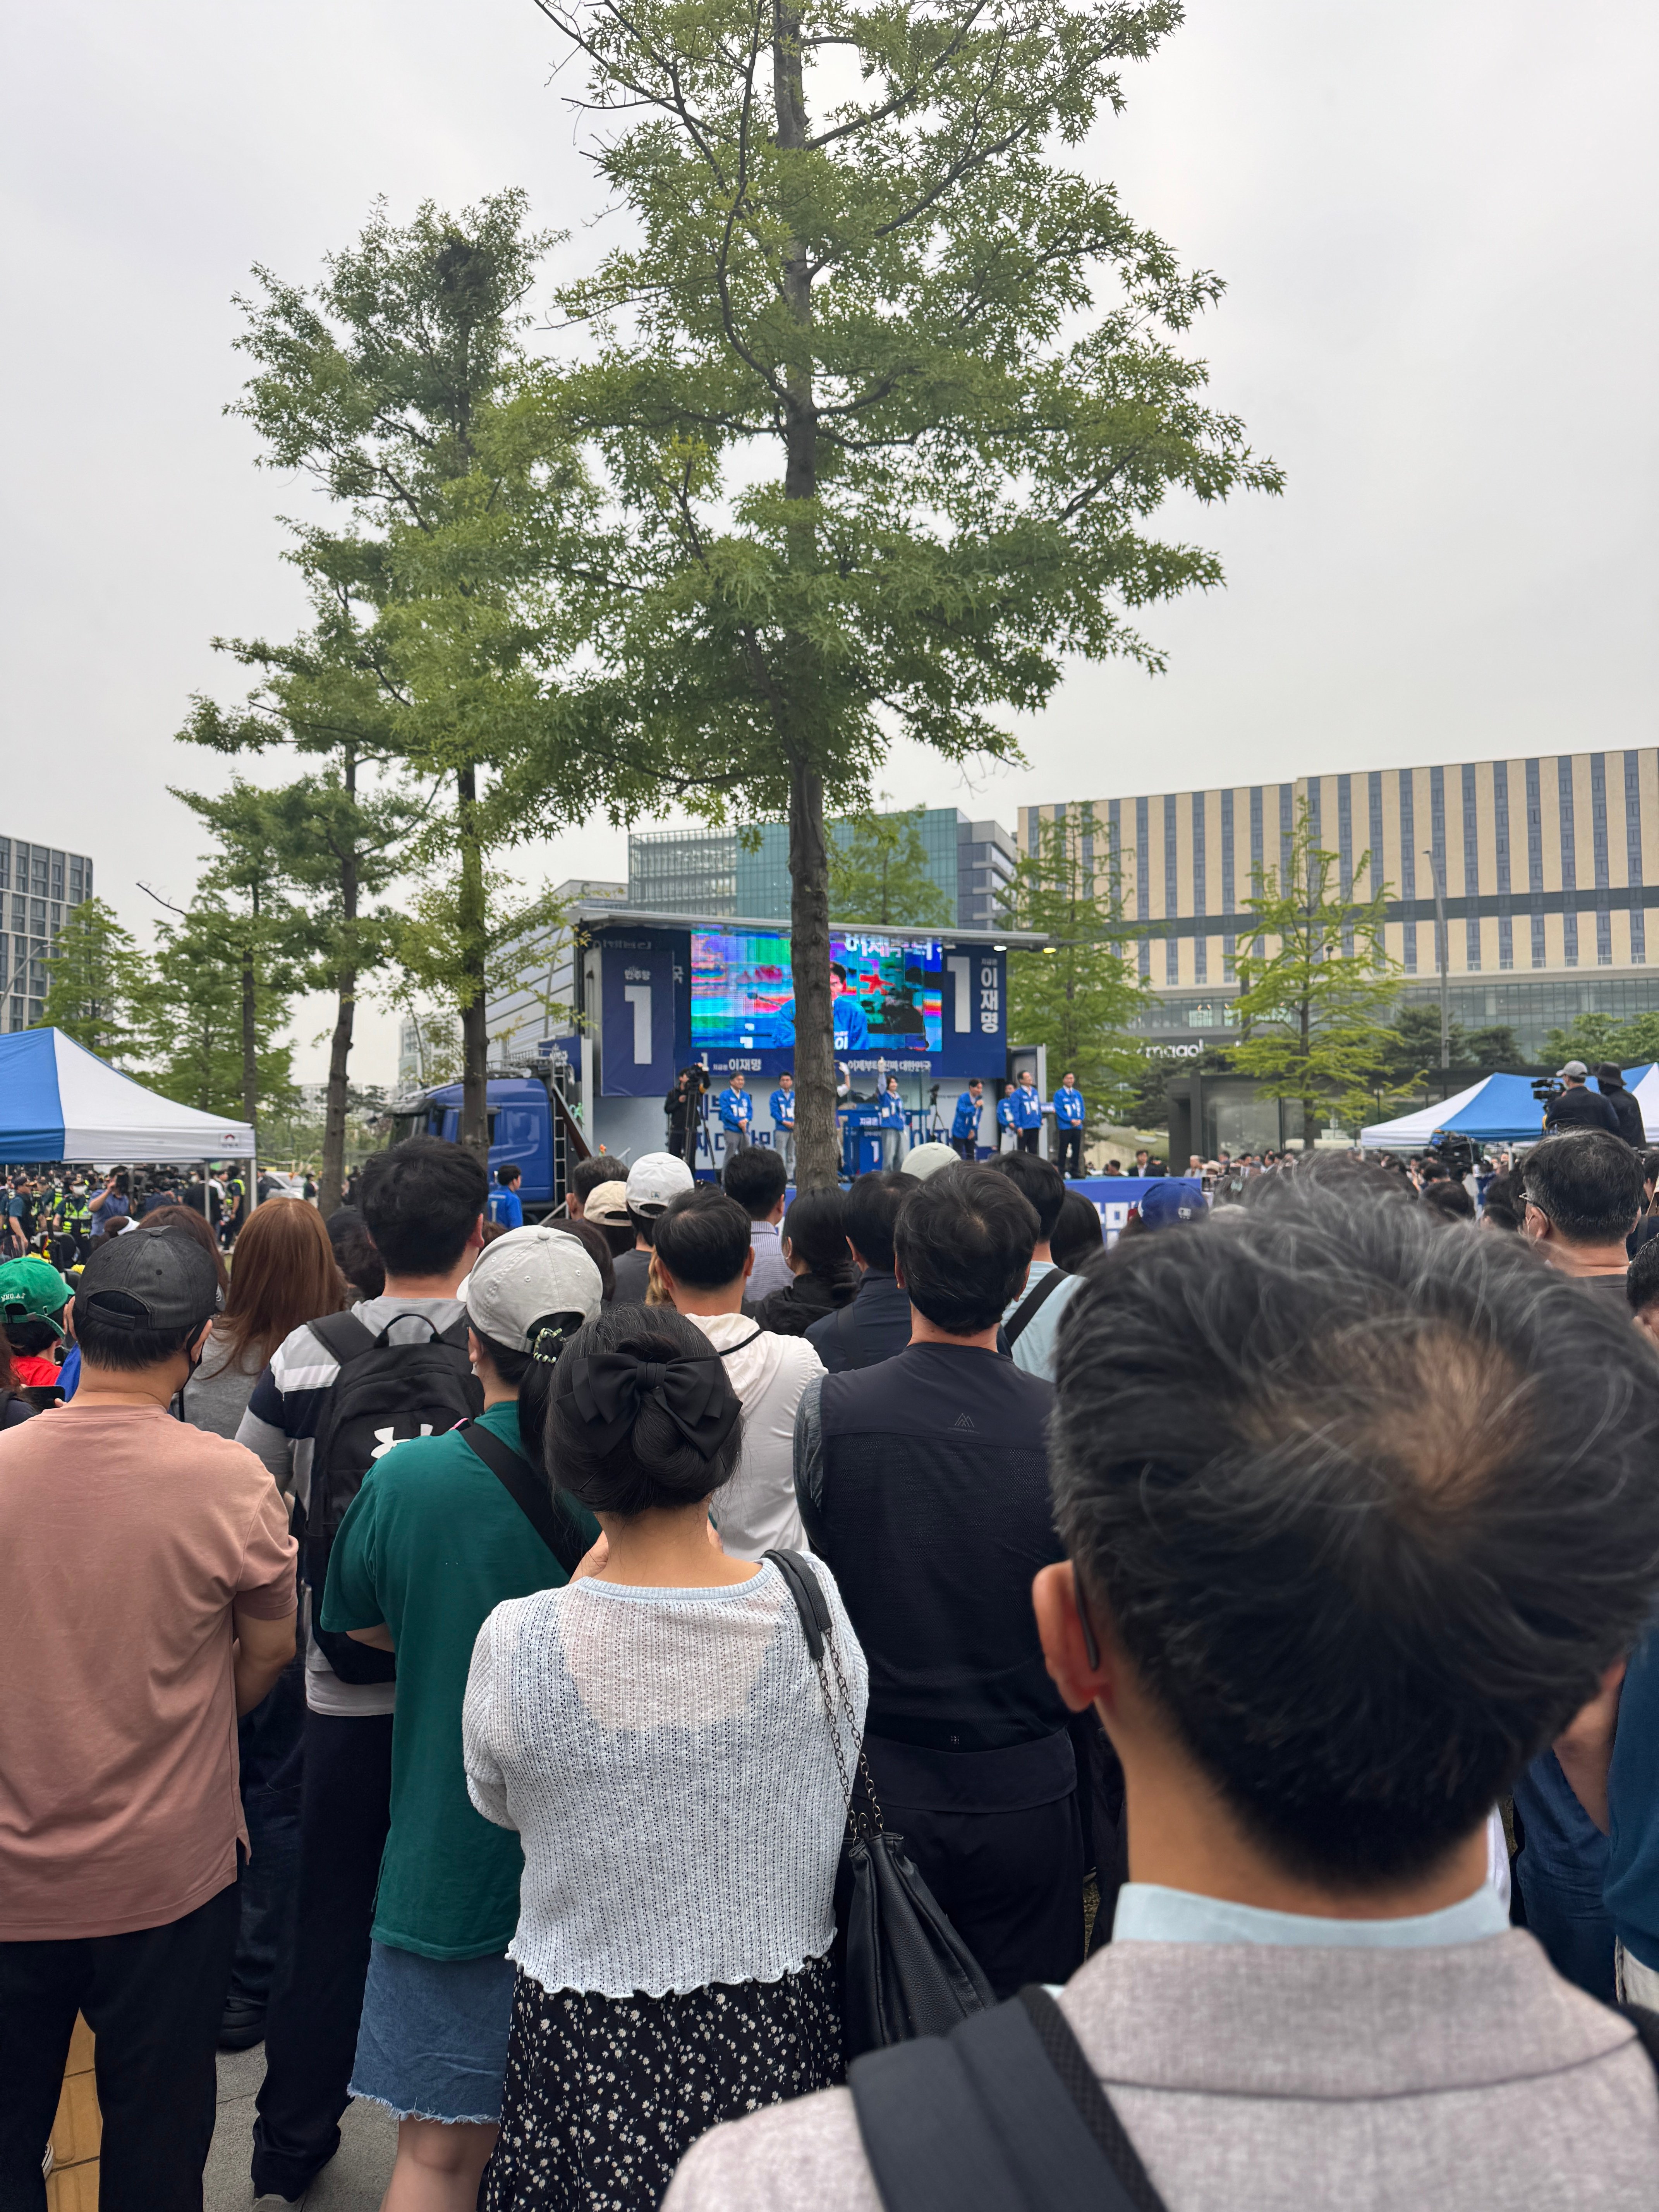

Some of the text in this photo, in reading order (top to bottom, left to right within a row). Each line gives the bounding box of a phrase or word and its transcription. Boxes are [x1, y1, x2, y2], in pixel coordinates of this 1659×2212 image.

[624, 985, 652, 1064] 1
[947, 956, 971, 1033] 1
[981, 967, 999, 1033] 이재명
[729, 1058, 762, 1071] 이재명
[871, 1141, 879, 1163] 1
